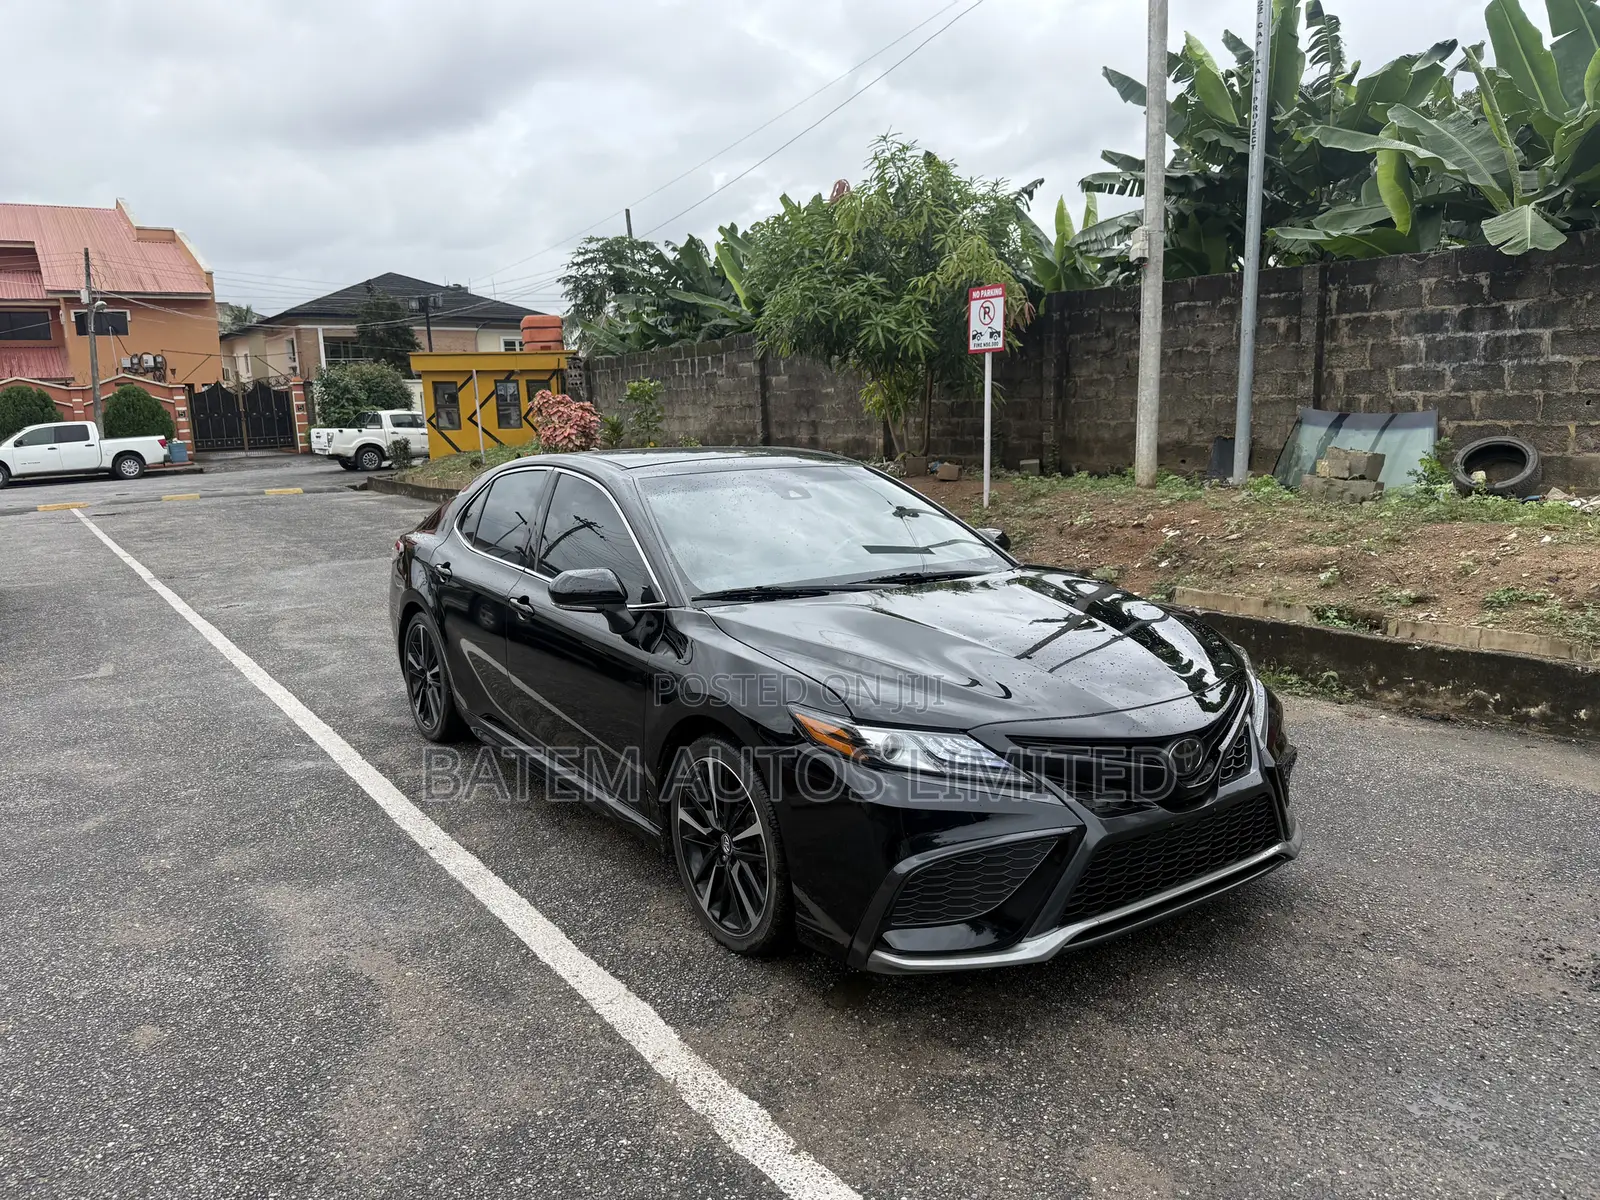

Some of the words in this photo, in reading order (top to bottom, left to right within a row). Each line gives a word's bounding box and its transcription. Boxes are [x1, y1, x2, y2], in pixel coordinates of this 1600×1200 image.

[1255, 22, 1263, 84] CAPITAL
[1251, 96, 1259, 150] PROJECT
[972, 290, 980, 299] NO
[981, 287, 1002, 298] PARKING
